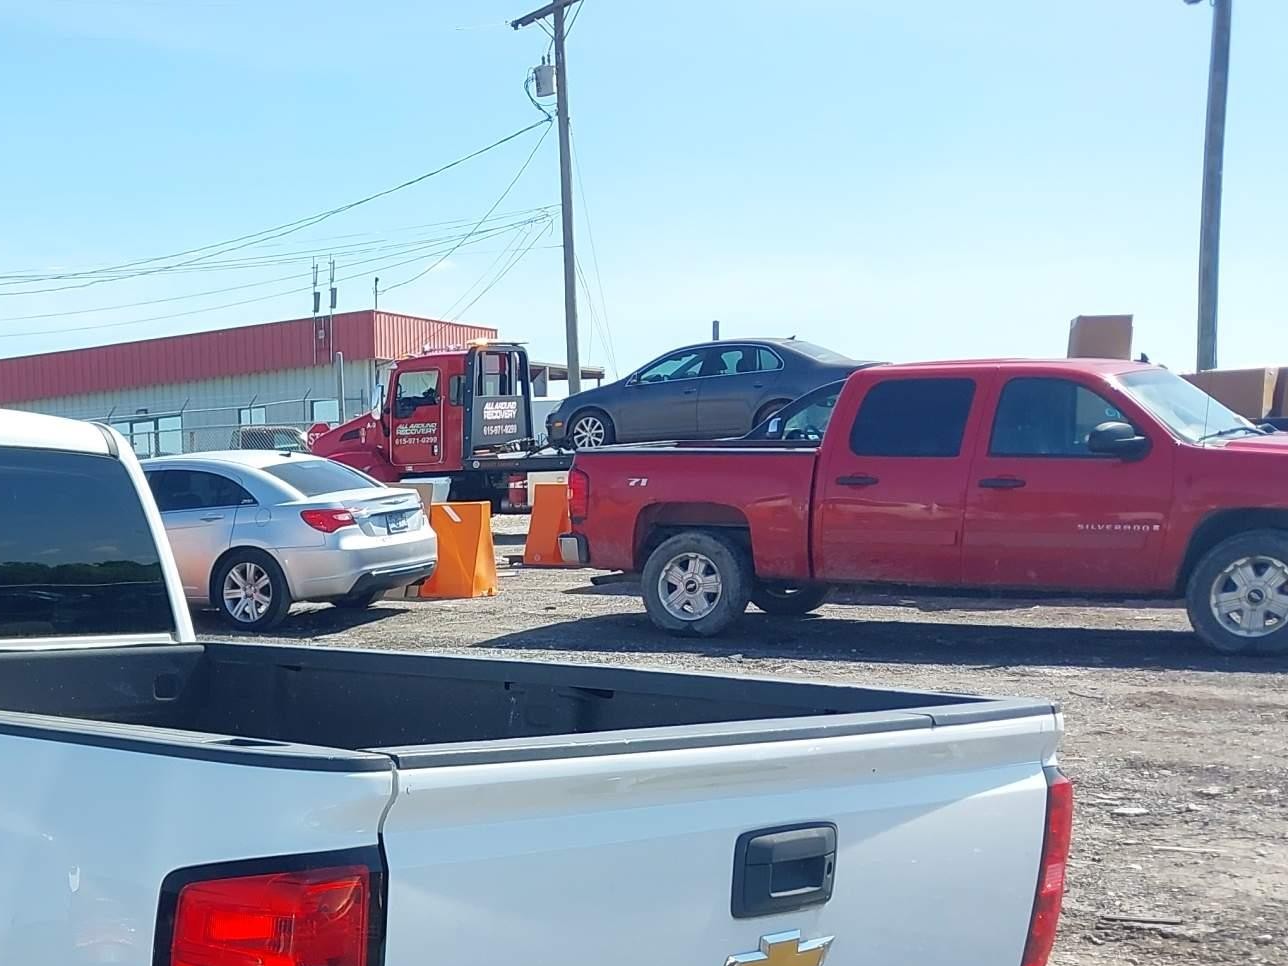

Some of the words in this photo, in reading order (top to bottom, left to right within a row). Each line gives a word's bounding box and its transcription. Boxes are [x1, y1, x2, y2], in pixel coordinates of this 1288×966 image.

[494, 401, 517, 410] AROUND
[483, 409, 518, 420] RECOVERY
[409, 422, 437, 430] AROUND
[395, 428, 437, 436] RECOVERY
[1077, 523, 1150, 532] SILVERADO
